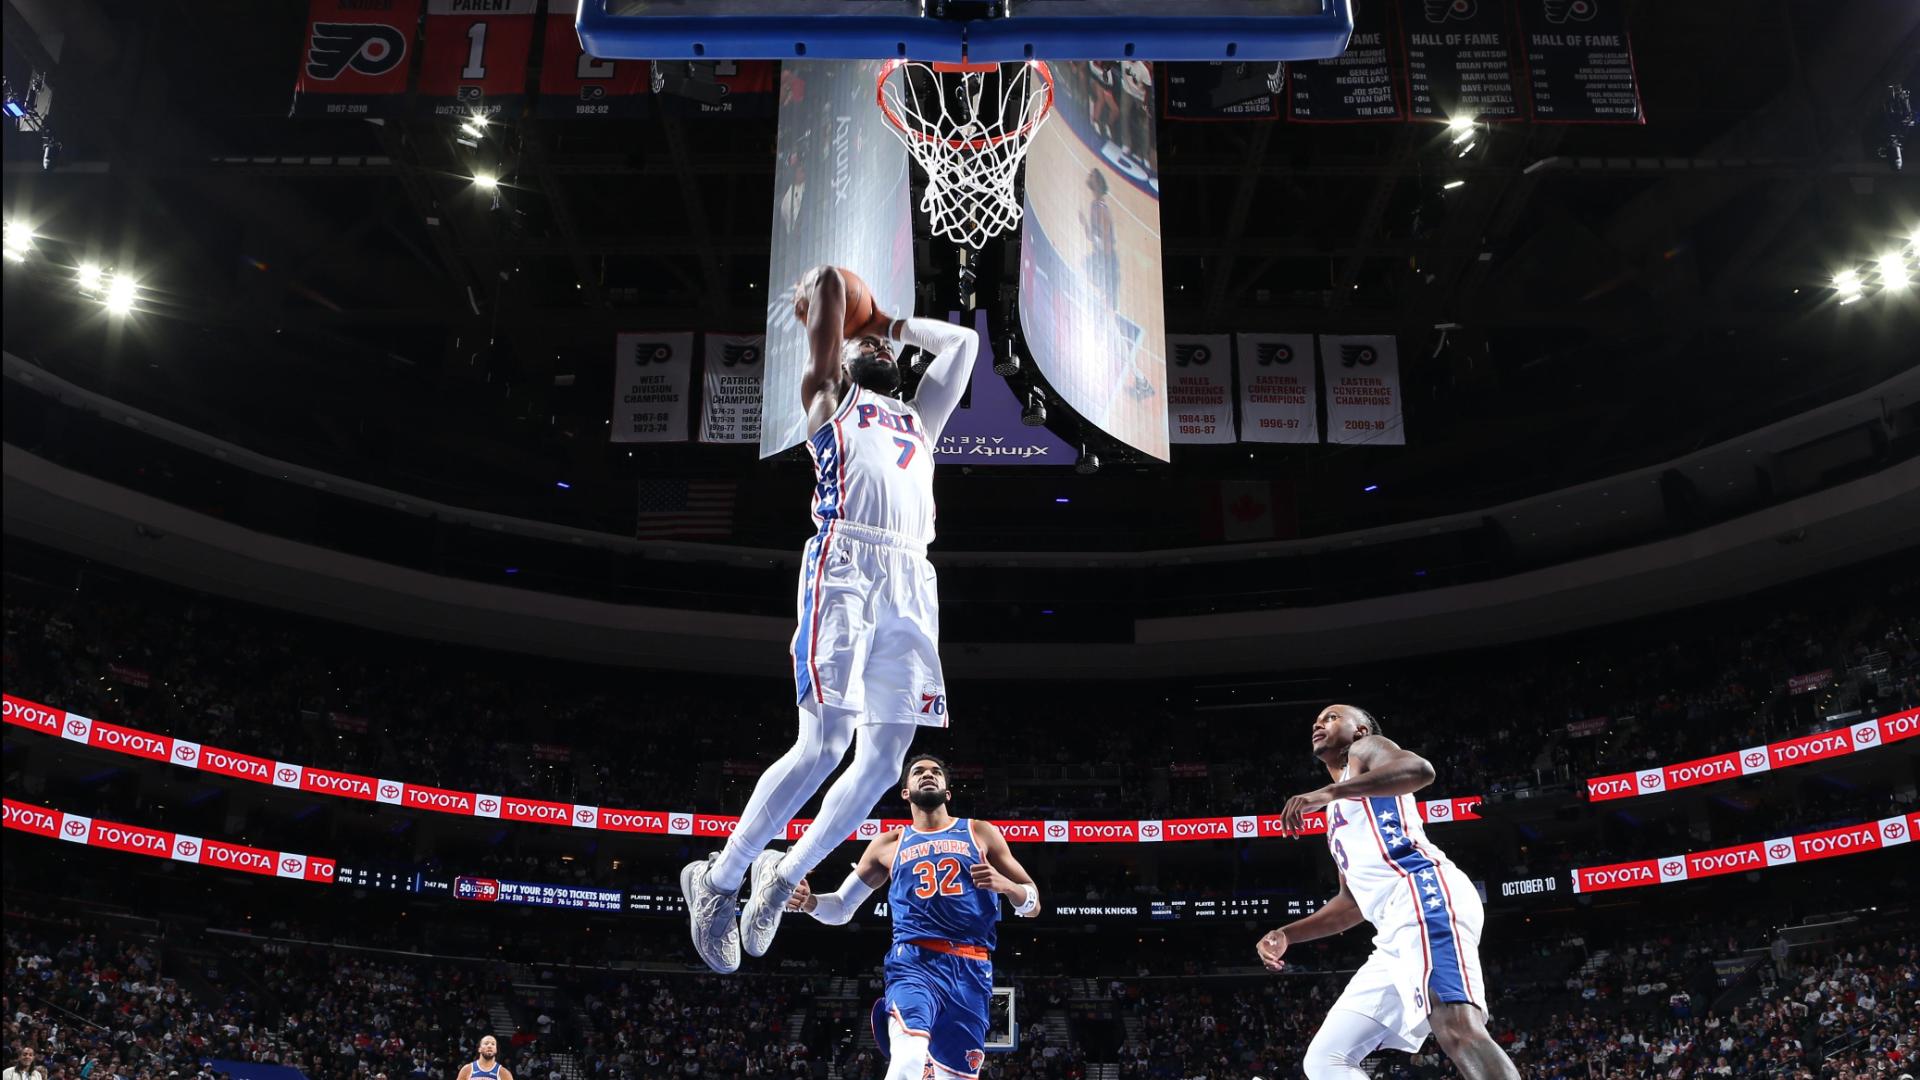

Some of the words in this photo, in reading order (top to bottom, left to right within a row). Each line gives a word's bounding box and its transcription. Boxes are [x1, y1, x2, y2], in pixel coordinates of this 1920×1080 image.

[1352, 33, 1381, 45] AME
[1412, 34, 1443, 45] HALL
[1445, 34, 1462, 45] OF
[1464, 34, 1500, 45] FAME
[1532, 34, 1564, 46] HALL
[1566, 34, 1582, 46] OF
[1585, 35, 1620, 46] FAME
[463, 23, 486, 78] 1
[831, 116, 851, 208] xfinity
[640, 375, 666, 384] WEST
[721, 376, 760, 385] PATRICK
[1179, 377, 1209, 385] WALES
[1256, 376, 1297, 385] EASTERN
[1341, 377, 1382, 386] EASTERN
[632, 385, 672, 394] DIVISION
[719, 386, 760, 395] DIVISION
[1248, 385, 1307, 394] CONFERENCE
[1333, 387, 1391, 396] CONFERENCE
[624, 394, 679, 403] CHAMPIONS
[1168, 395, 1223, 404] CHAMPIONS
[1250, 395, 1305, 404] CHAMPIONS
[1335, 396, 1391, 405] CHAMPIONS
[857, 403, 924, 442] PHIL
[1259, 418, 1299, 428] 1996-97
[943, 436, 1004, 444] AREN
[893, 436, 916, 469] 7
[969, 445, 1048, 458] xfinity
[922, 693, 945, 715] 76
[1670, 760, 1734, 782] TOYOTA
[1775, 736, 1846, 760] TOYOTA
[1885, 716, 1920, 735] TOY
[98, 728, 164, 754] TOYOTA
[207, 753, 267, 776] TOYOTA
[308, 774, 370, 794] TOYOTA
[410, 790, 468, 808] TOYOTA
[508, 803, 566, 819] TOYOTA
[604, 814, 662, 827] TOYOTA
[698, 819, 738, 834] TOYO
[1000, 826, 1039, 836] YOTA
[1075, 826, 1132, 836] TOYOTA
[1169, 823, 1227, 834] TOYOTA
[1263, 818, 1324, 832] TOTA
[98, 827, 165, 850] TOYOTA
[208, 847, 270, 868] TOYOTA
[901, 842, 931, 864] NEW
[932, 840, 971, 857] YORK
[1586, 867, 1652, 884] TOYOTA
[1693, 851, 1759, 870] TOYOTA
[1801, 831, 1874, 853] TOYOTA
[912, 857, 963, 899] 32
[459, 884, 471, 892] 50
[483, 886, 495, 894] 50
[1502, 879, 1544, 896] OCTOBER
[1545, 877, 1555, 891] 10
[501, 884, 518, 893] BUY
[520, 885, 541, 895] YOUR
[543, 886, 567, 898] 50/50
[569, 889, 597, 900] TICKETS
[599, 892, 621, 902] NOW!
[542, 896, 553, 904] $25
[606, 902, 621, 910] $100
[1057, 907, 1077, 915] NEW
[1079, 907, 1103, 915] YORK
[1105, 907, 1138, 915] KNICKS
